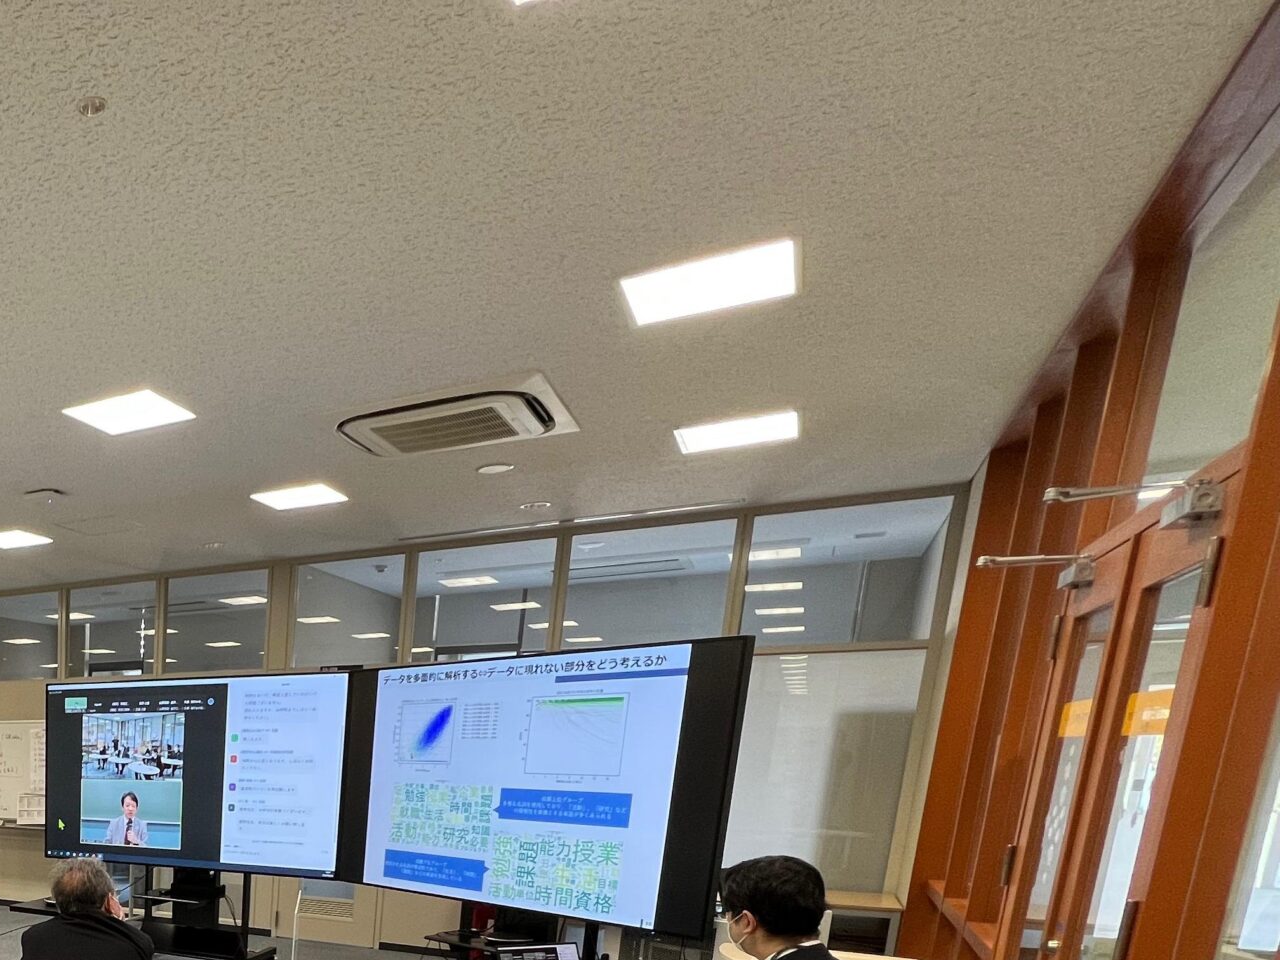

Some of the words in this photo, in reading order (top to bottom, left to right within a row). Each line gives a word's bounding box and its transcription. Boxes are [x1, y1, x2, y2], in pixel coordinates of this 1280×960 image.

[449, 801, 472, 815] 時間
[442, 826, 470, 844] 研究
[539, 839, 571, 858] 能力
[572, 839, 621, 866] 授業
[515, 841, 539, 888] 課題
[534, 884, 574, 910] 時間
[573, 890, 613, 915] 資格
